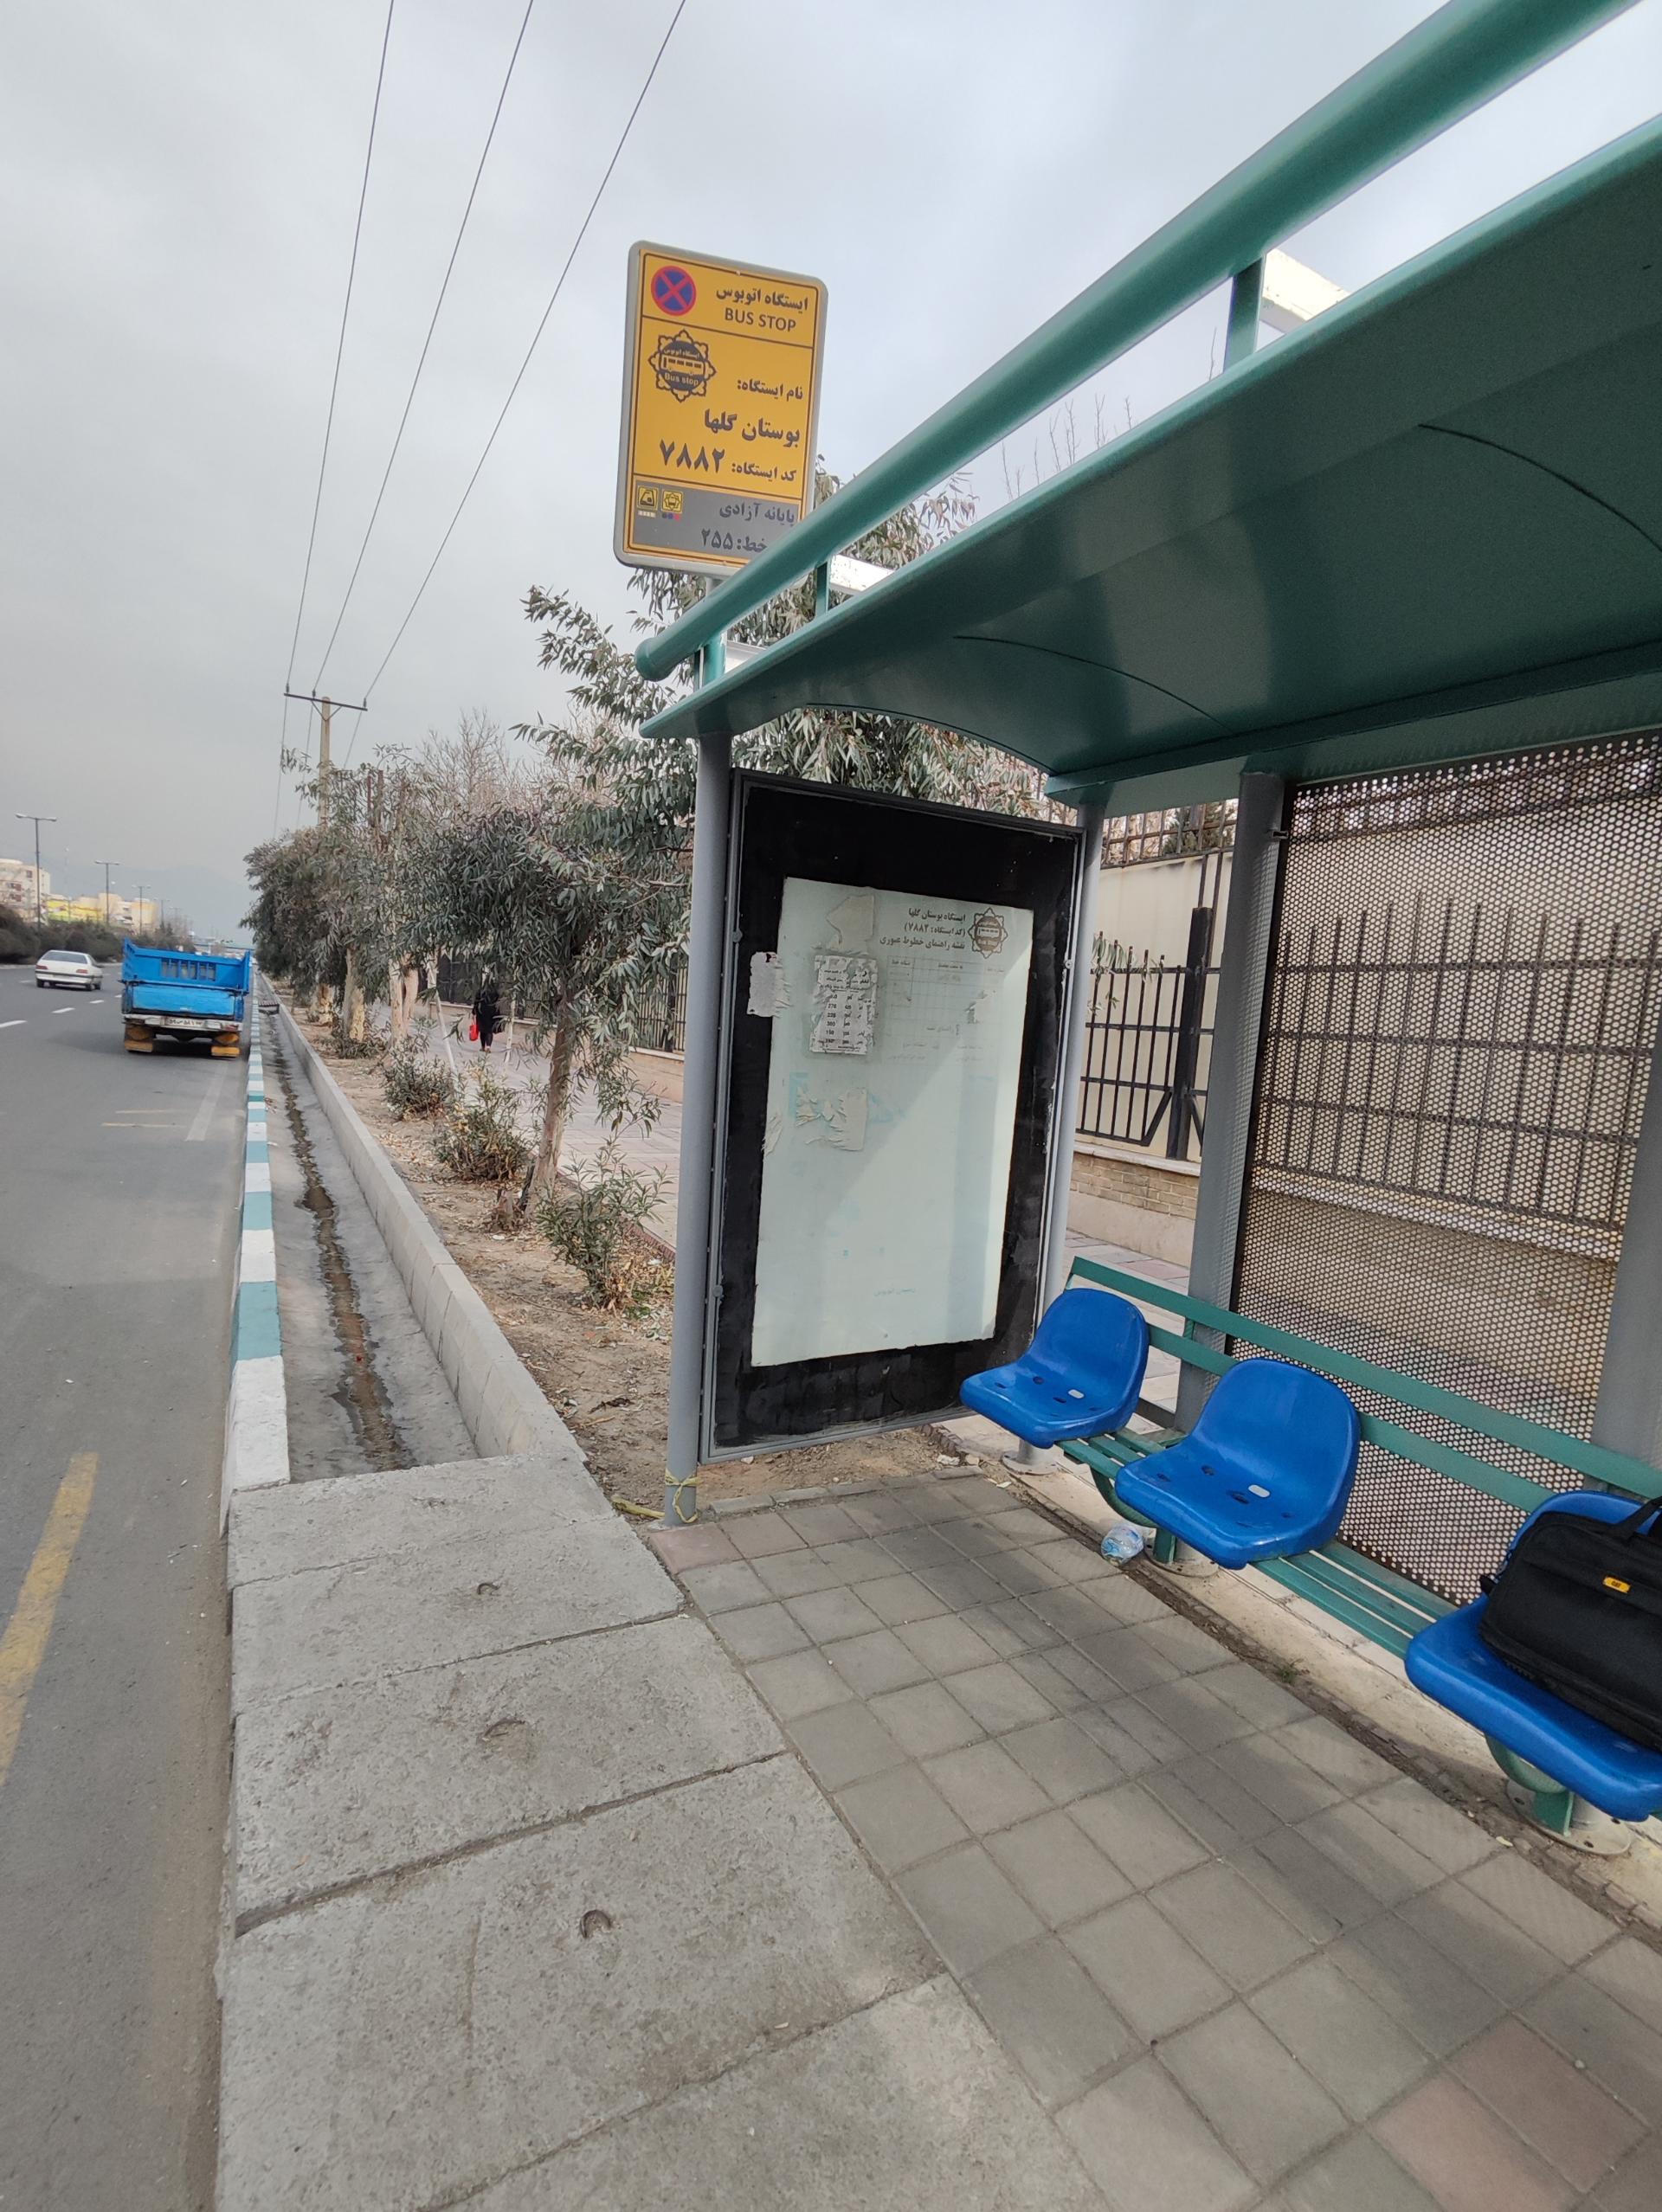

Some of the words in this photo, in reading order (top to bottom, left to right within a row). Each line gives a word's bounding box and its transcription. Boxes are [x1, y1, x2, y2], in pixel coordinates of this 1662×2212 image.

[716, 287, 762, 305] اتوبوس
[764, 292, 808, 314] ایستگاه
[725, 307, 754, 325] BUS
[758, 314, 796, 332] STOP
[665, 372, 680, 383] Bus
[682, 376, 699, 387] stop
[738, 378, 783, 399] ایستگاه:
[786, 386, 803, 402] نام
[705, 408, 738, 434] گلها
[742, 417, 800, 447] بوستان
[660, 439, 725, 473] ۷۸۸۲
[731, 461, 778, 482] ایستگاه:
[781, 469, 796, 481] کد
[719, 502, 763, 521] آزادی
[921, 910, 943, 922] بوستان
[944, 912, 966, 924] ایستگاه
[903, 936, 924, 948] خطوط
